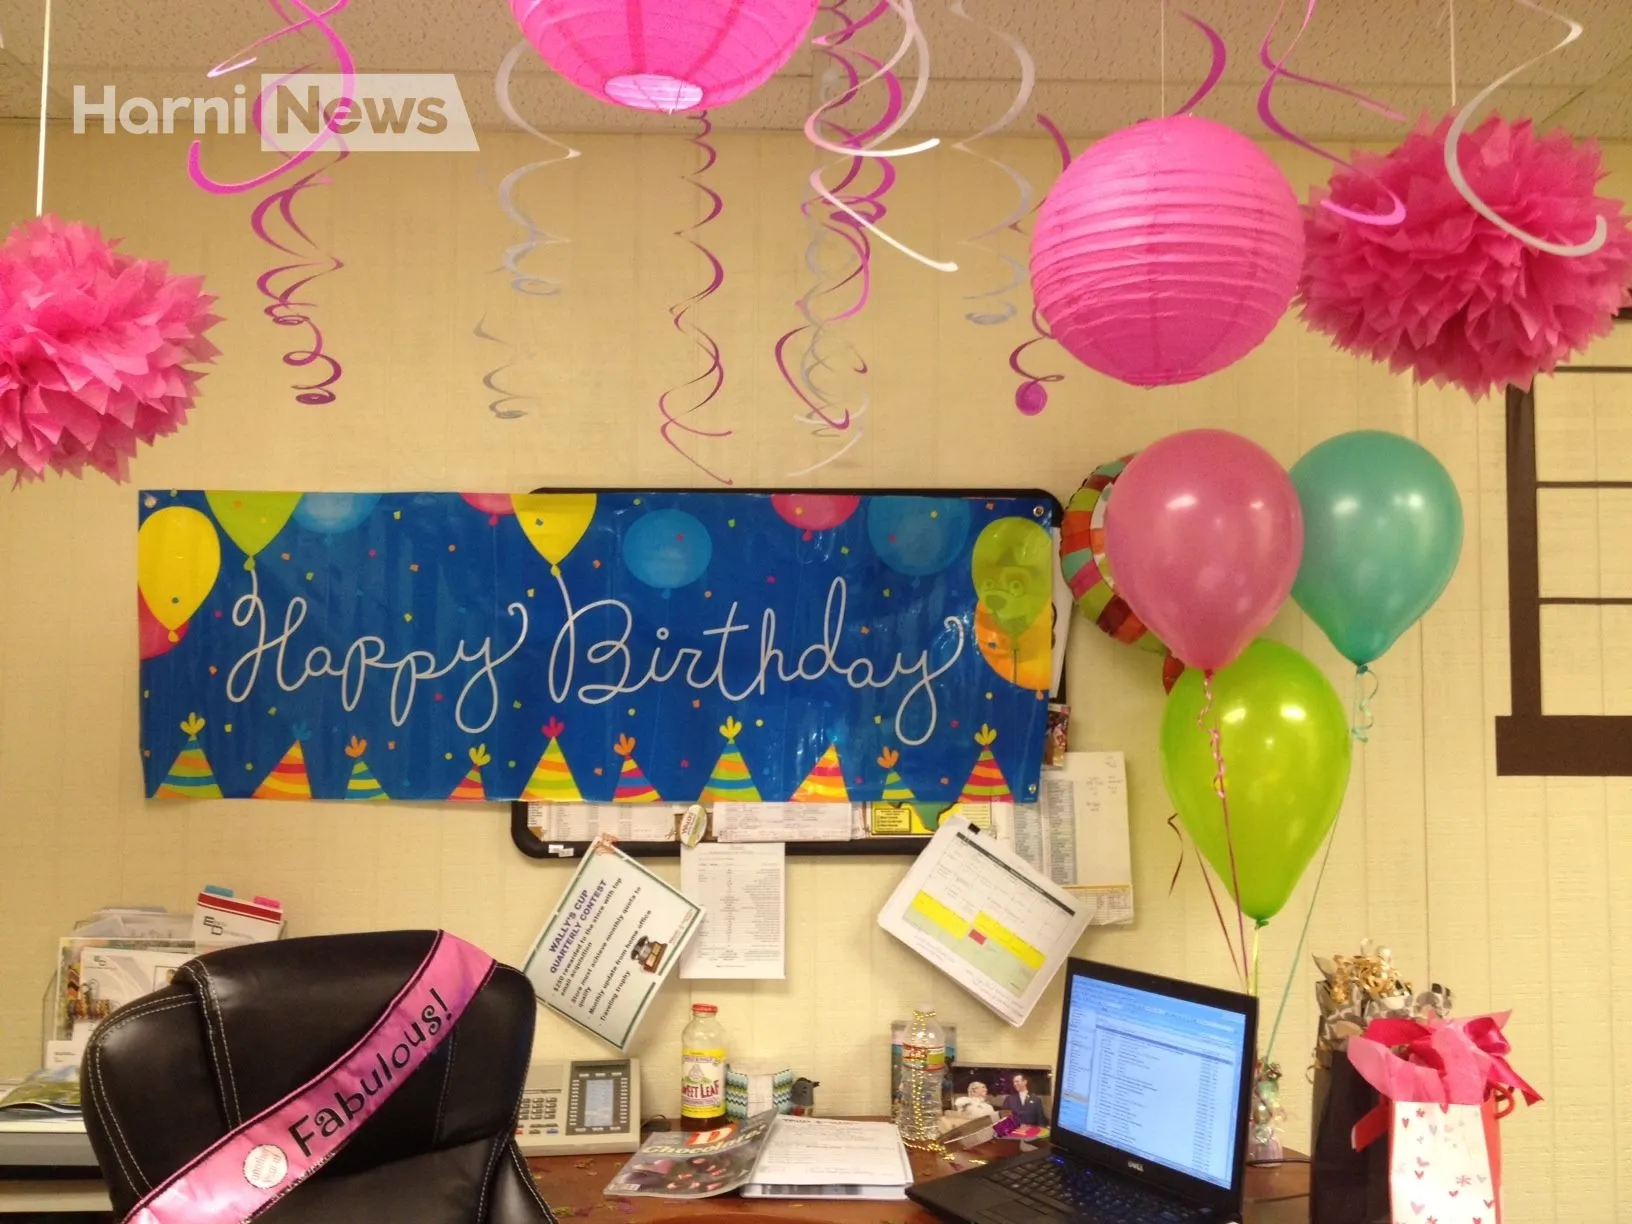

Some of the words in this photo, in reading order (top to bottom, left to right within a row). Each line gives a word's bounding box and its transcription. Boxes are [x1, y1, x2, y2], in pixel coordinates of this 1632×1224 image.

[227, 590, 529, 734] Happy
[548, 576, 964, 747] Birthday
[602, 889, 615, 905] with
[612, 877, 622, 890] top
[549, 911, 577, 953] WALLY'S
[574, 889, 588, 910] CUP
[549, 922, 582, 974] QUARTERLY
[579, 879, 607, 921] CONTEST
[584, 924, 594, 939] the
[592, 905, 605, 924] store
[562, 945, 582, 976] rewarded
[571, 985, 583, 1004] Store
[580, 966, 593, 986] must
[591, 941, 608, 968] achieve
[606, 914, 625, 943] monthly
[622, 895, 638, 915] quota
[634, 886, 641, 897] to
[581, 936, 588, 947] to
[588, 989, 605, 1015] Monthly
[603, 966, 618, 992] update
[615, 948, 629, 967] from
[625, 930, 639, 949] home
[638, 909, 652, 930] office
[553, 975, 565, 993] $250
[560, 978, 572, 997] email
[570, 941, 593, 979] acquisition
[577, 985, 593, 1008] qualify
[599, 992, 620, 1022] Traveling
[616, 970, 631, 995] trophy
[288, 987, 453, 1158] Fabulous!
